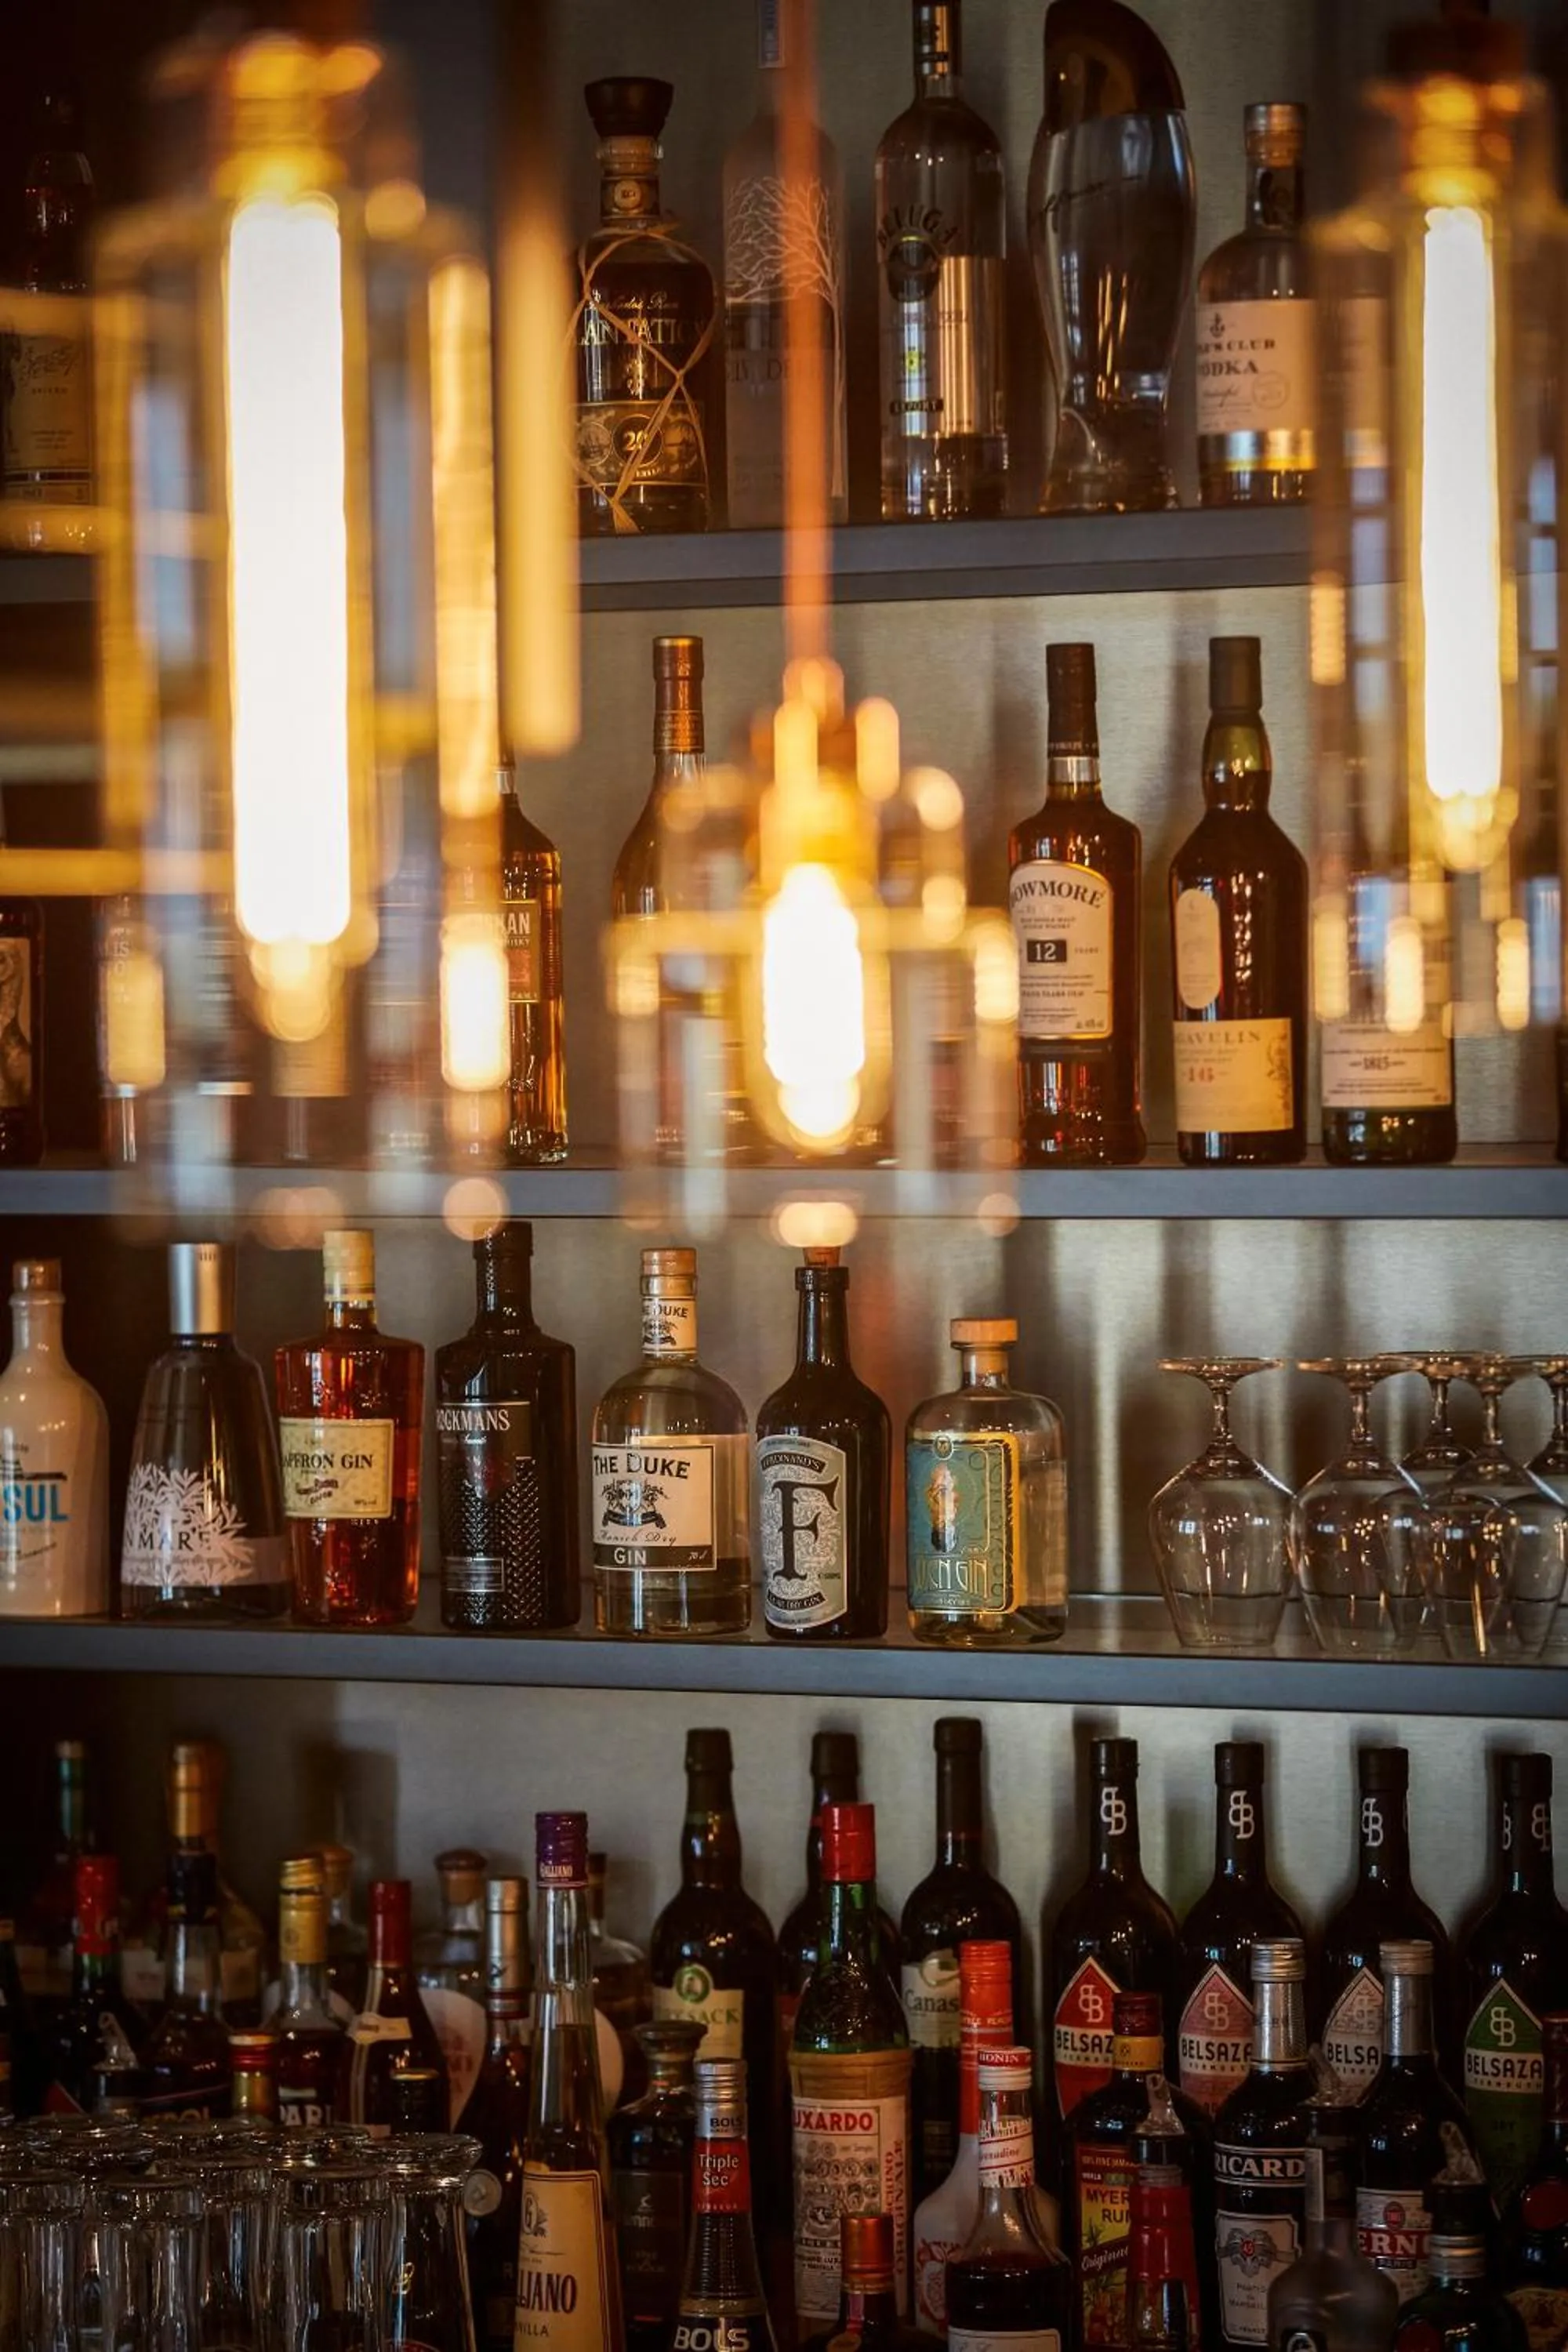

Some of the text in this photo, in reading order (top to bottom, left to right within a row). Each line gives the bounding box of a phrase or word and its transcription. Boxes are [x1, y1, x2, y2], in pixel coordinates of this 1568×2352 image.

[1035, 942, 1057, 961] 12
[340, 1454, 373, 1469] GIN
[593, 1452, 691, 1480] THE DUKE
[3, 1483, 69, 1523] SUL
[137, 1530, 213, 1552] MARE
[771, 1475, 840, 1581] F
[614, 1547, 647, 1566] GIN
[955, 1557, 988, 1599] GIN
[1056, 2028, 1115, 2054] BELSAZ
[1327, 2042, 1379, 2066] BELSA
[1466, 2053, 1543, 2081] BELSAZA
[699, 2153, 740, 2172] Triple
[1213, 2151, 1306, 2179] RICARD
[702, 2171, 729, 2187] Sec
[673, 2323, 752, 2352] BOLS
